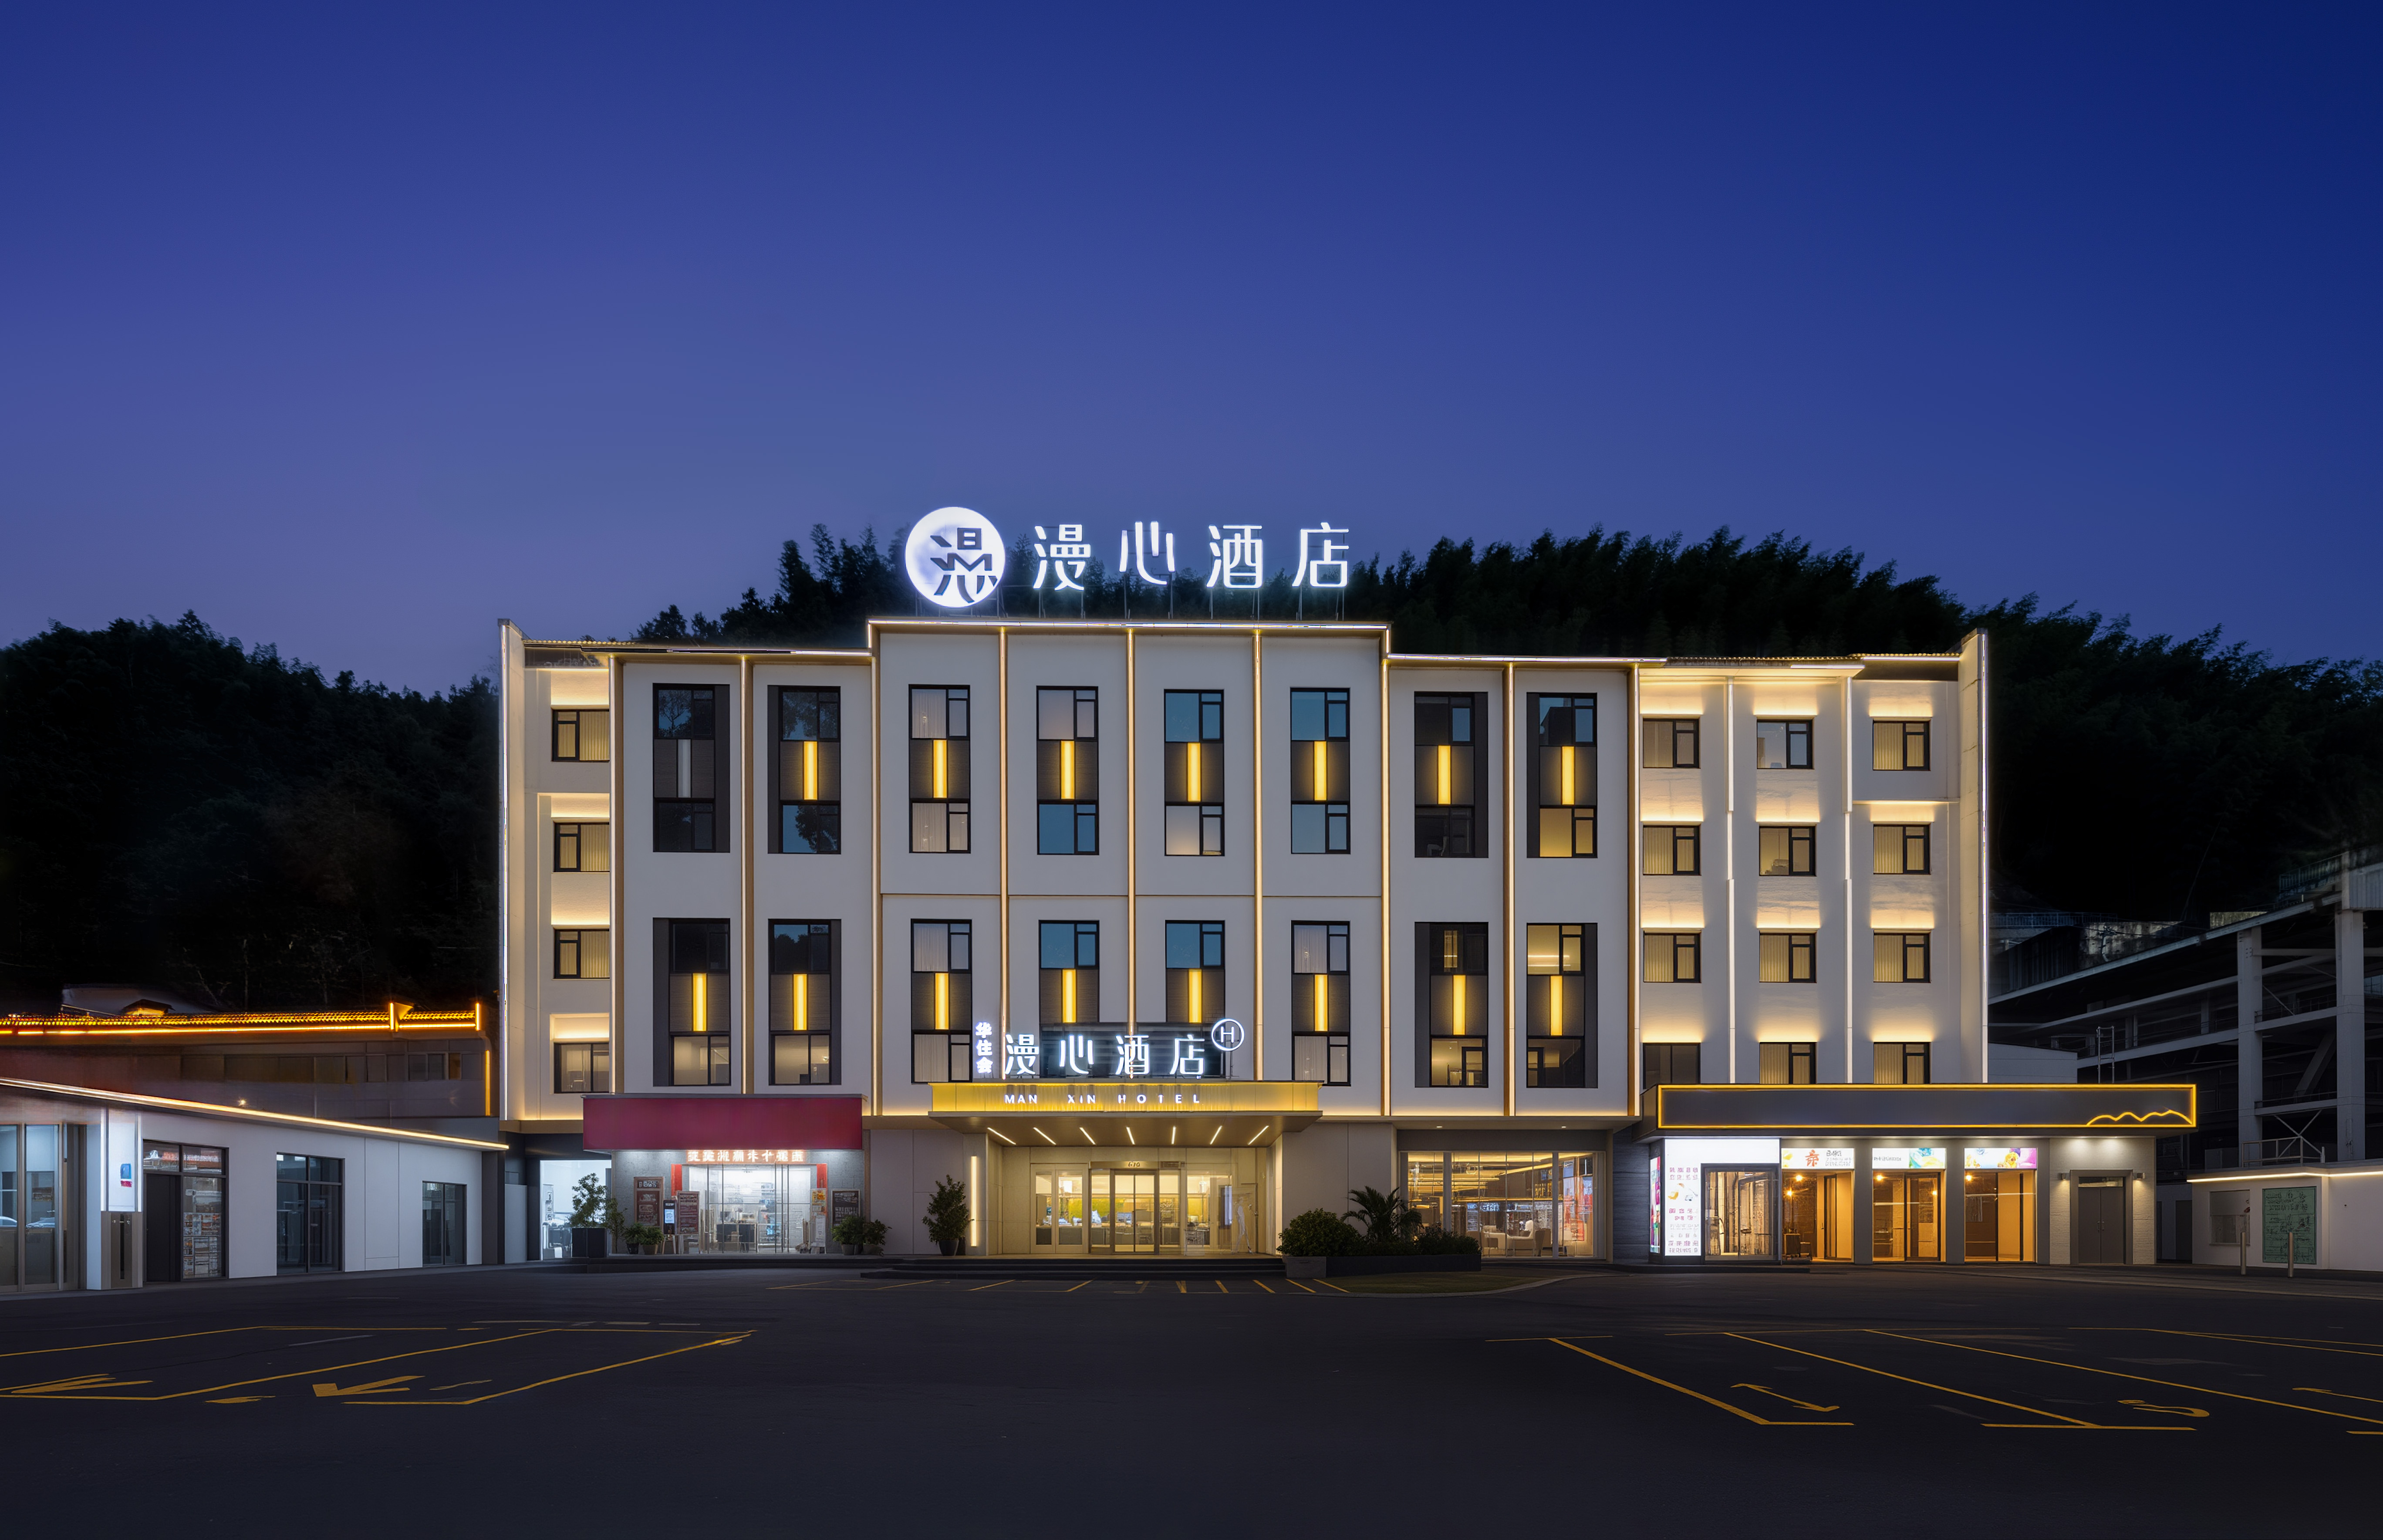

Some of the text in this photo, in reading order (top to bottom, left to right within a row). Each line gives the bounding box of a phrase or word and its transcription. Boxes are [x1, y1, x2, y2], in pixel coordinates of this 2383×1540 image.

[1033, 521, 1349, 591] 漫心酒店
[975, 1022, 993, 1074] 华住会
[1005, 1033, 1205, 1075] 漫心酒店
[1004, 1094, 1200, 1104] MAN XIN HOTEL
